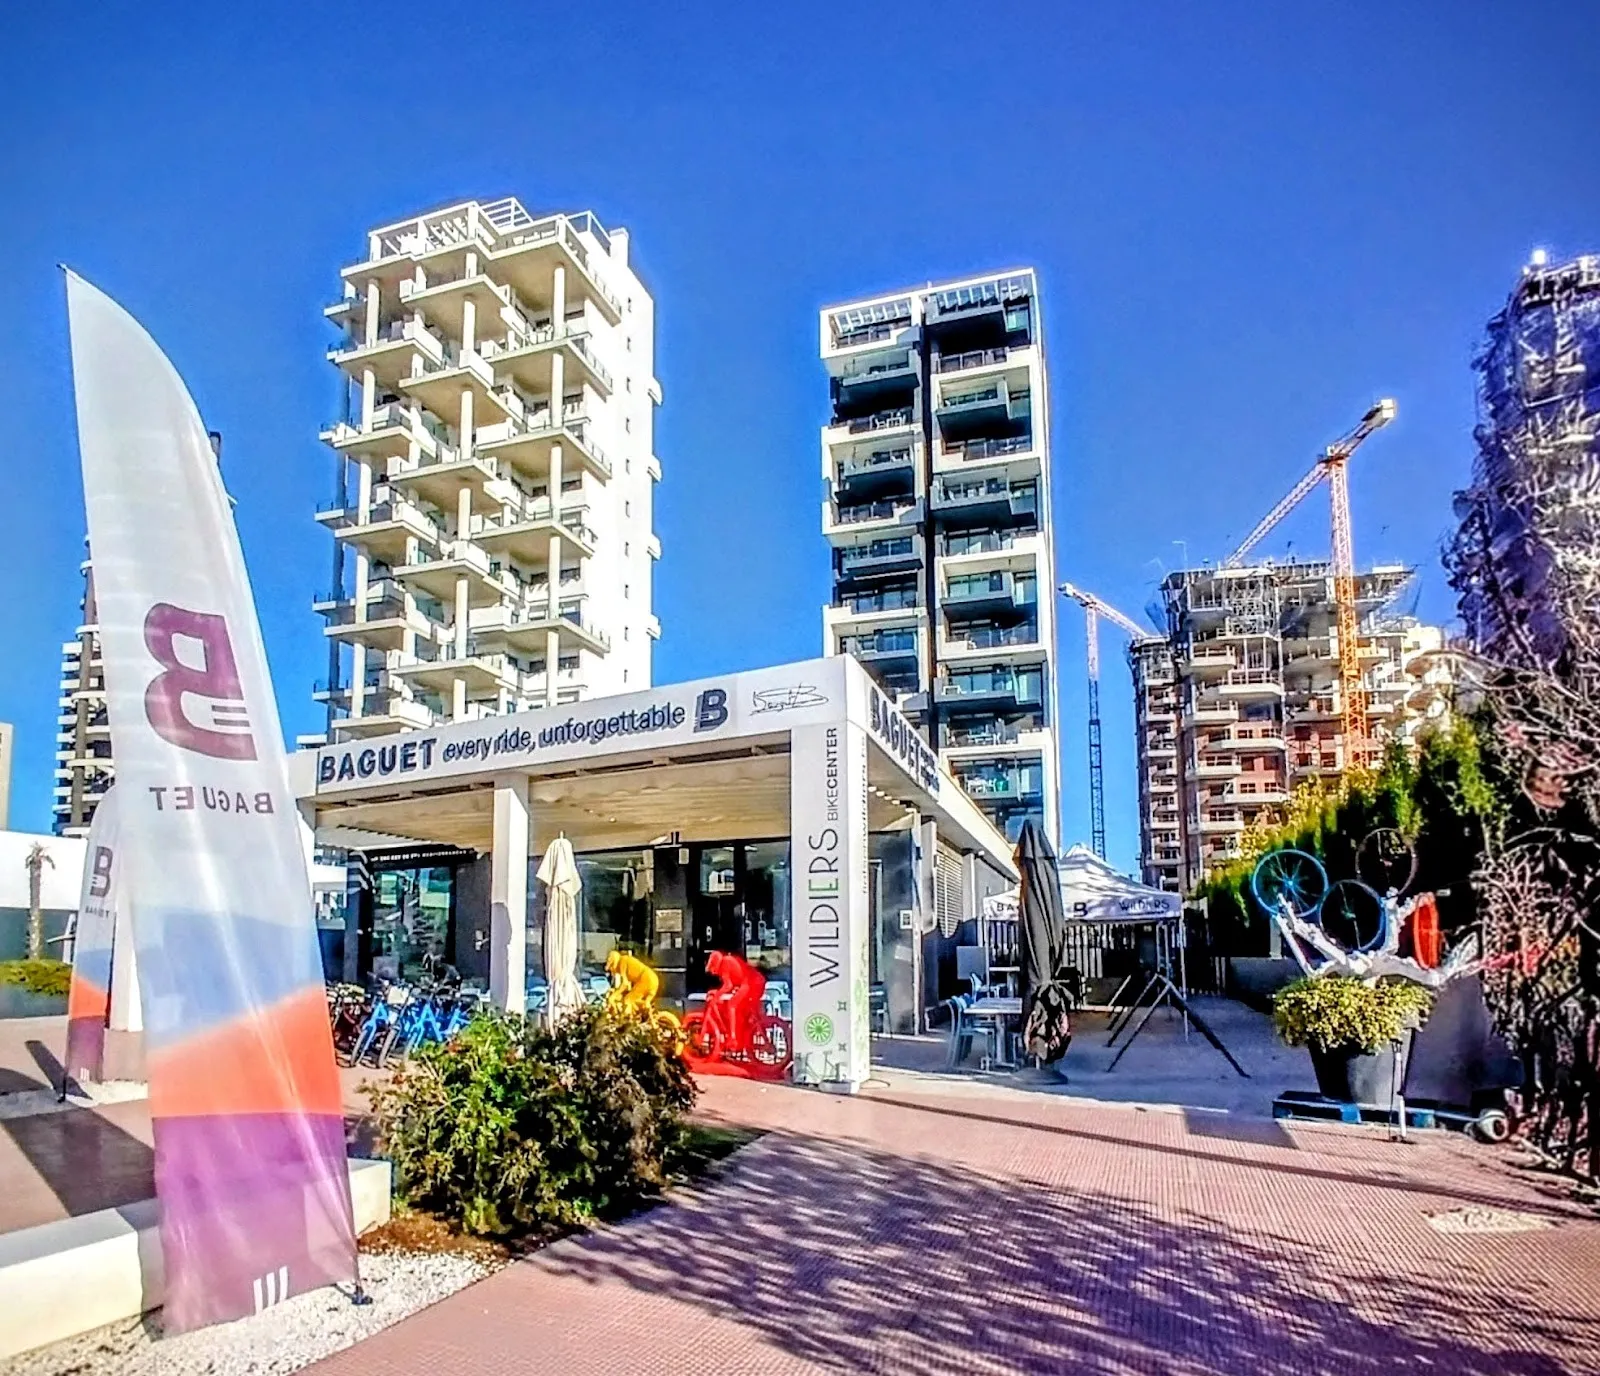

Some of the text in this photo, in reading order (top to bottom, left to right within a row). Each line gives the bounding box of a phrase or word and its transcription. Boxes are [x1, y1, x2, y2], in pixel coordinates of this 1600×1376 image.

[319, 738, 437, 785] BAGUET
[443, 736, 493, 763] every
[493, 726, 537, 756] ride,
[538, 702, 685, 748] unforgettable
[693, 688, 729, 733] B
[870, 686, 920, 784] BAGUET
[90, 846, 114, 898] B
[808, 727, 840, 988] WILDIERS BIKECENTER
[1073, 901, 1089, 918] B
